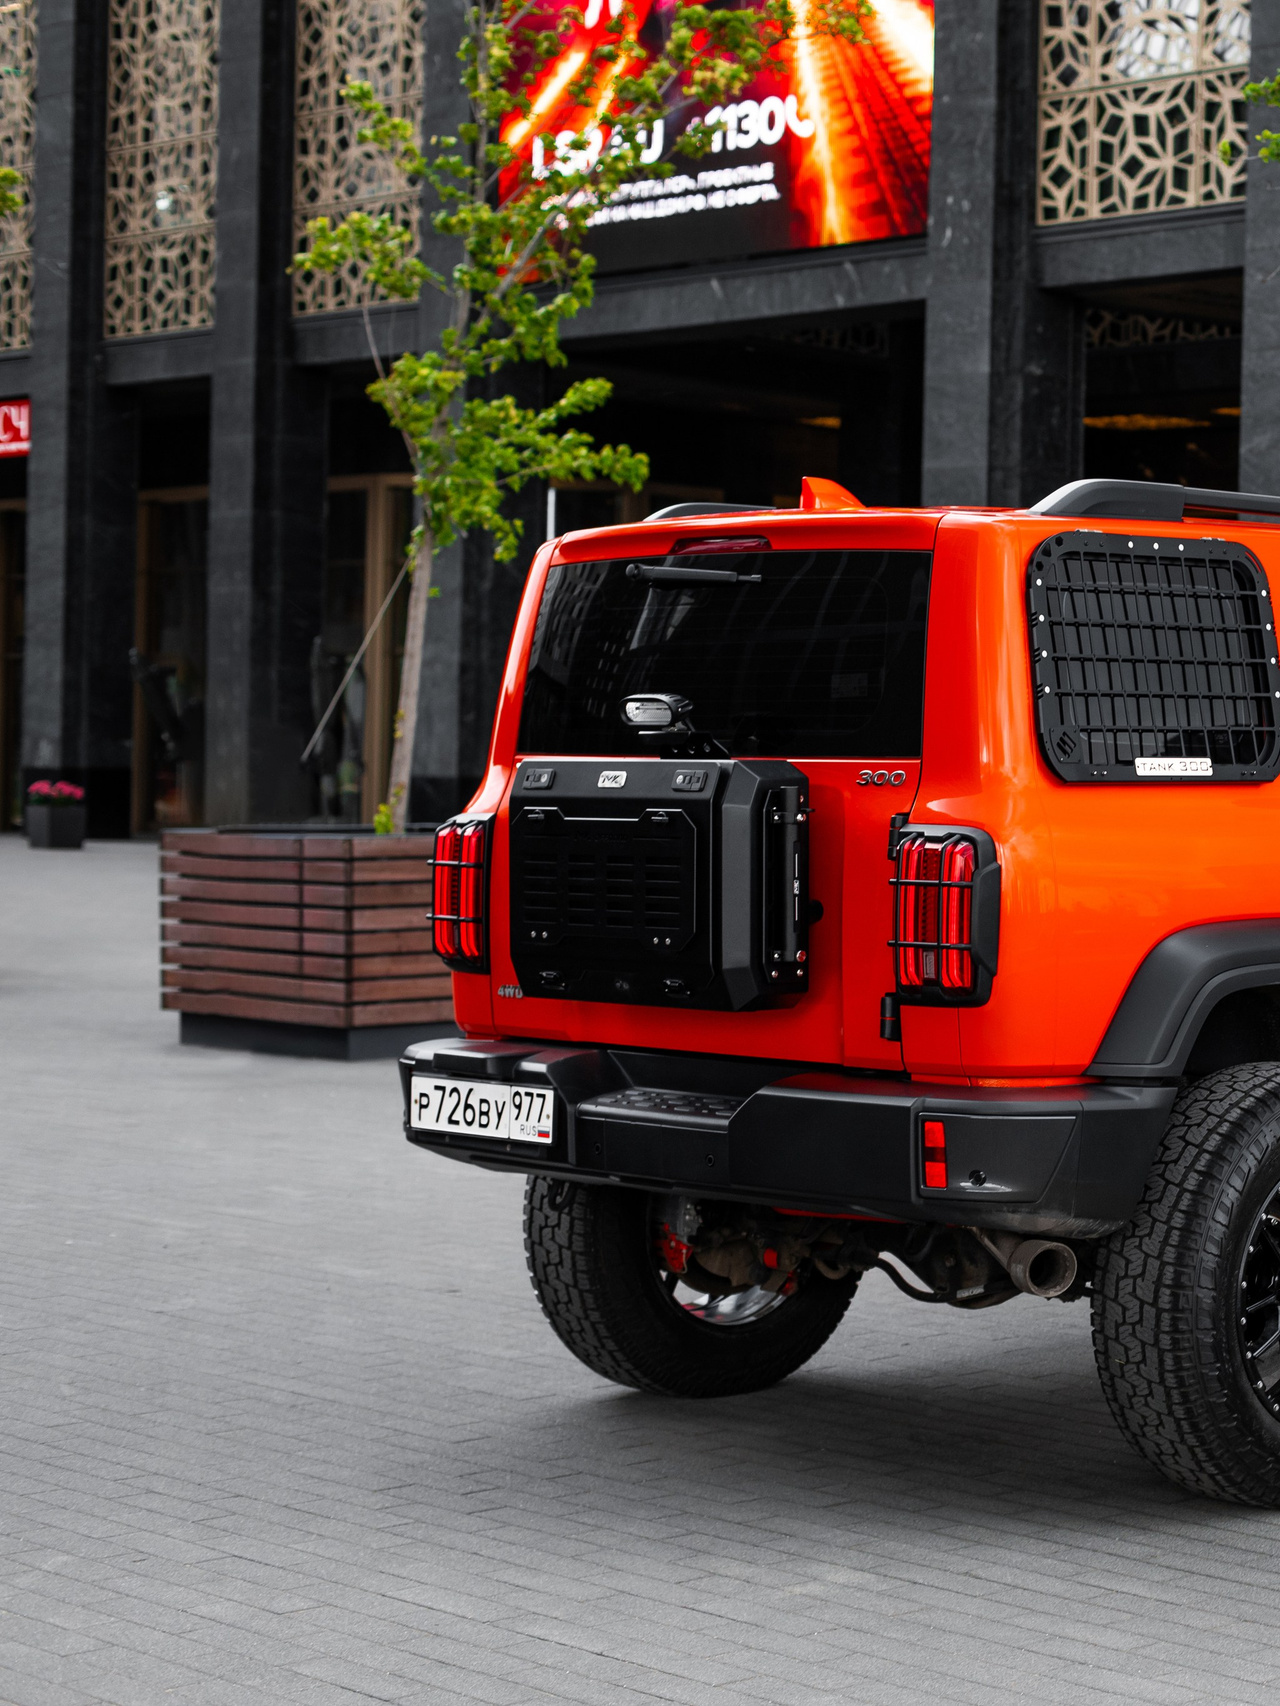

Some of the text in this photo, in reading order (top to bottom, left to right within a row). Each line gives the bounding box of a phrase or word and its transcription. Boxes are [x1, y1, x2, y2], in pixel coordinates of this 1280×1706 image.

[1140, 761, 1209, 772] TANK 300
[856, 769, 906, 787] 300
[497, 984, 524, 999] 4WD
[512, 1090, 547, 1124] 977
[520, 1125, 537, 1137] RUS
